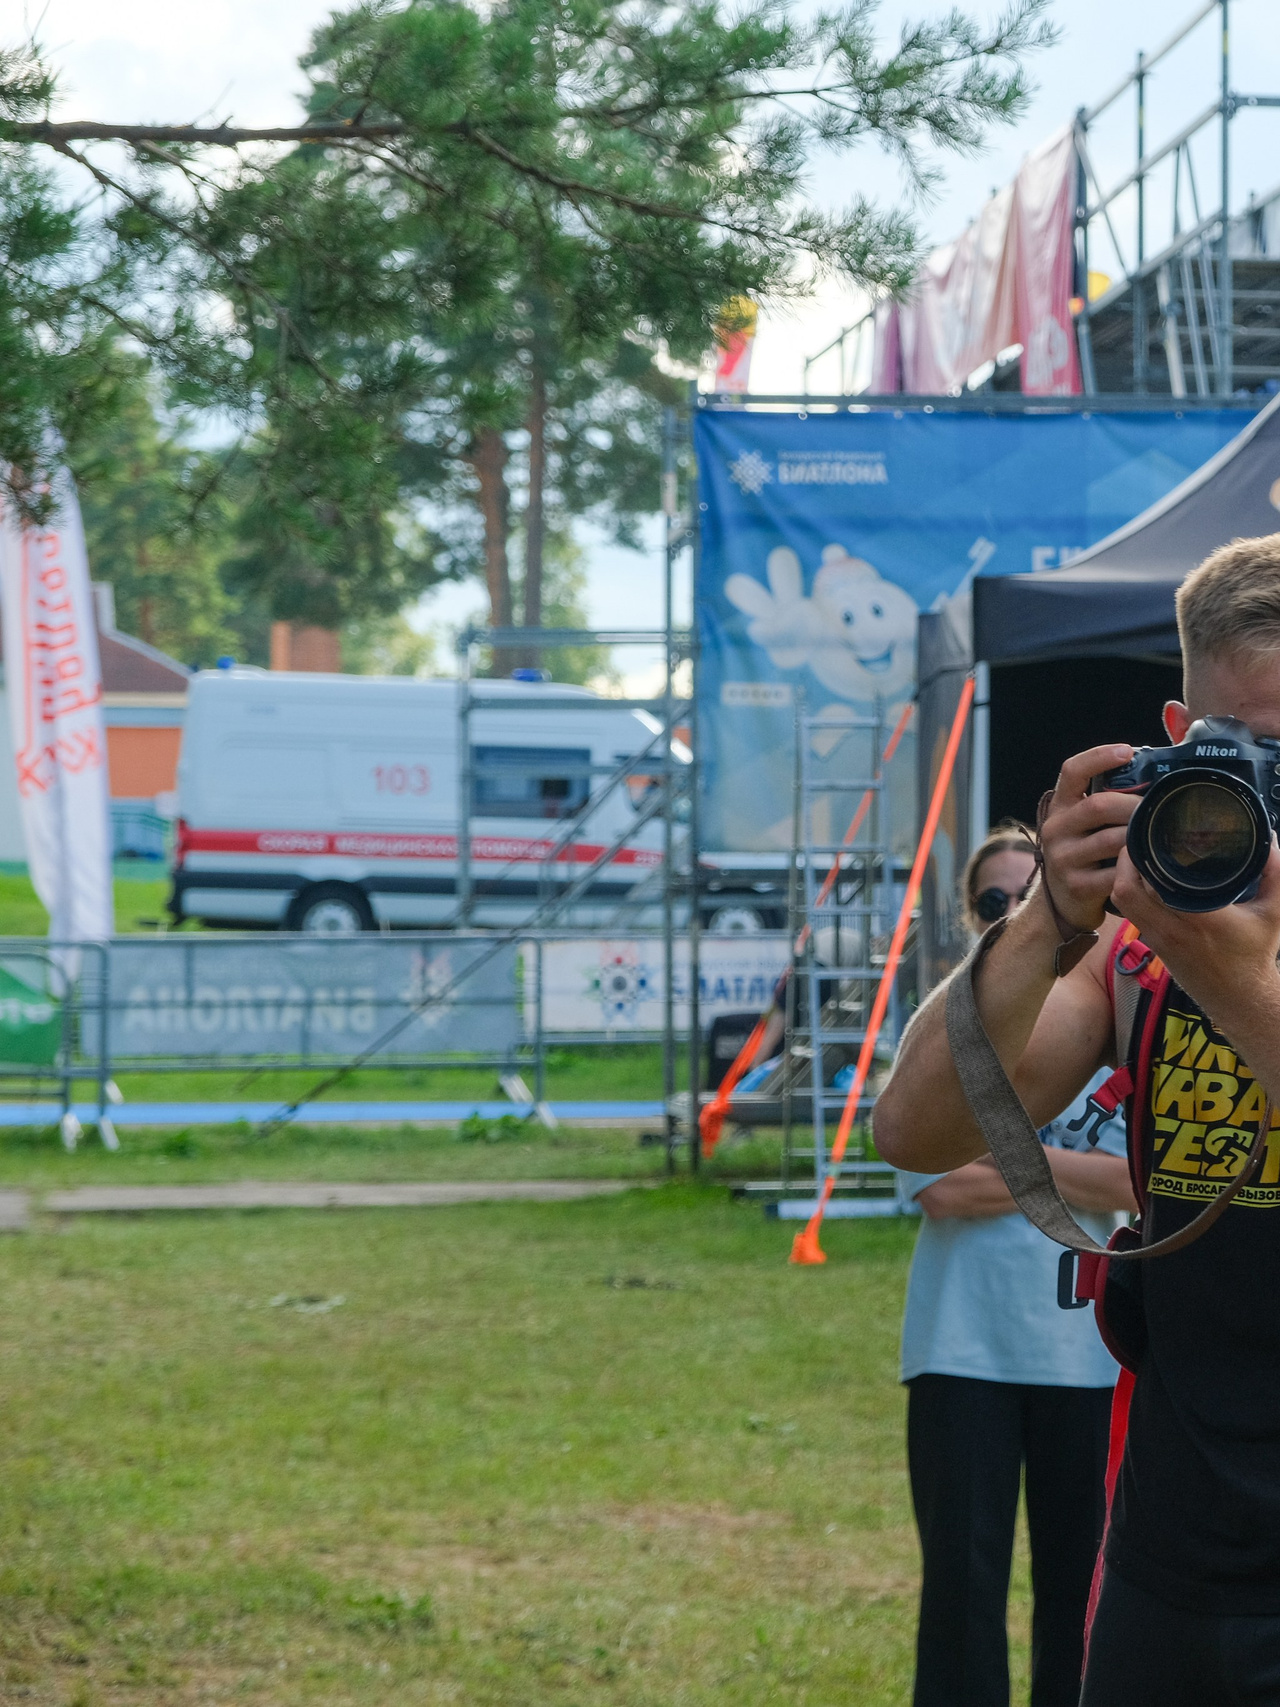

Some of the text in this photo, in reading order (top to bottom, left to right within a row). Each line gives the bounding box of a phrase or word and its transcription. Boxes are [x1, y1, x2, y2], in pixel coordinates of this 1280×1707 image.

[1195, 745, 1238, 757] Nikon
[1156, 764, 1171, 772] D4
[373, 764, 432, 796] 103
[1151, 1175, 1184, 1193] ОРОД
[1186, 1182, 1227, 1196] БРОСАЕ
